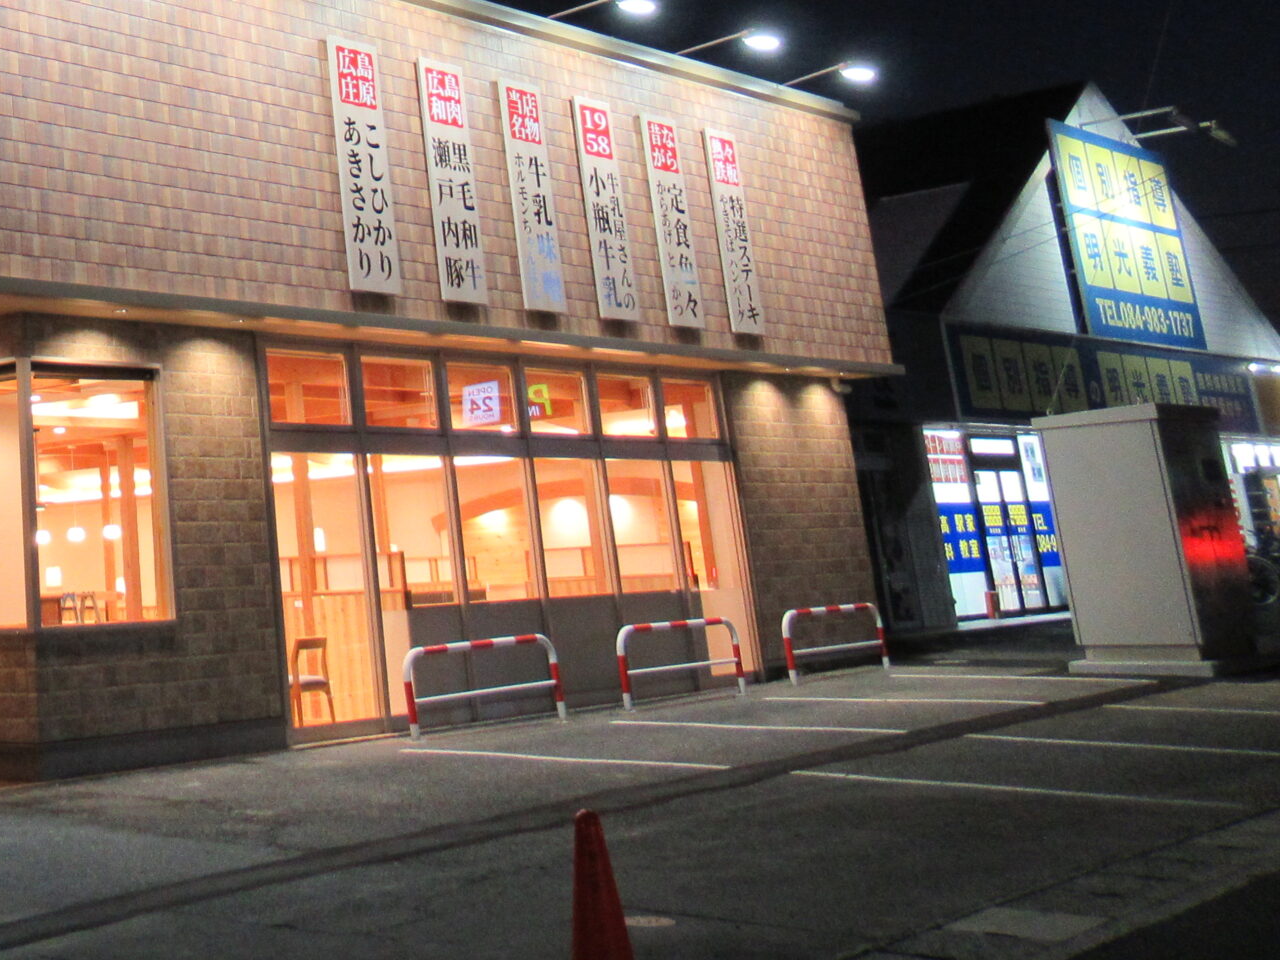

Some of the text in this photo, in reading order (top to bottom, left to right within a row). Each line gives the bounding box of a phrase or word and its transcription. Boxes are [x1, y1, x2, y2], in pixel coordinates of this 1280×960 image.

[338, 48, 373, 80] 広島
[341, 76, 377, 106] 庄原
[426, 70, 460, 100] 広島
[508, 89, 538, 117] 当店
[511, 115, 541, 144] 名物
[344, 116, 372, 279] あきさかり
[365, 123, 392, 282] こしひかり
[431, 136, 465, 289] 瀬戸内豚
[452, 141, 483, 290] 黒毛和牛
[528, 155, 563, 304] 牛乳味
[589, 166, 622, 308] 小瓶牛乳
[606, 172, 636, 311] 牛乳屋さんの
[729, 194, 759, 326] 特選ステーキ
[1084, 232, 1186, 289] 明光義塾
